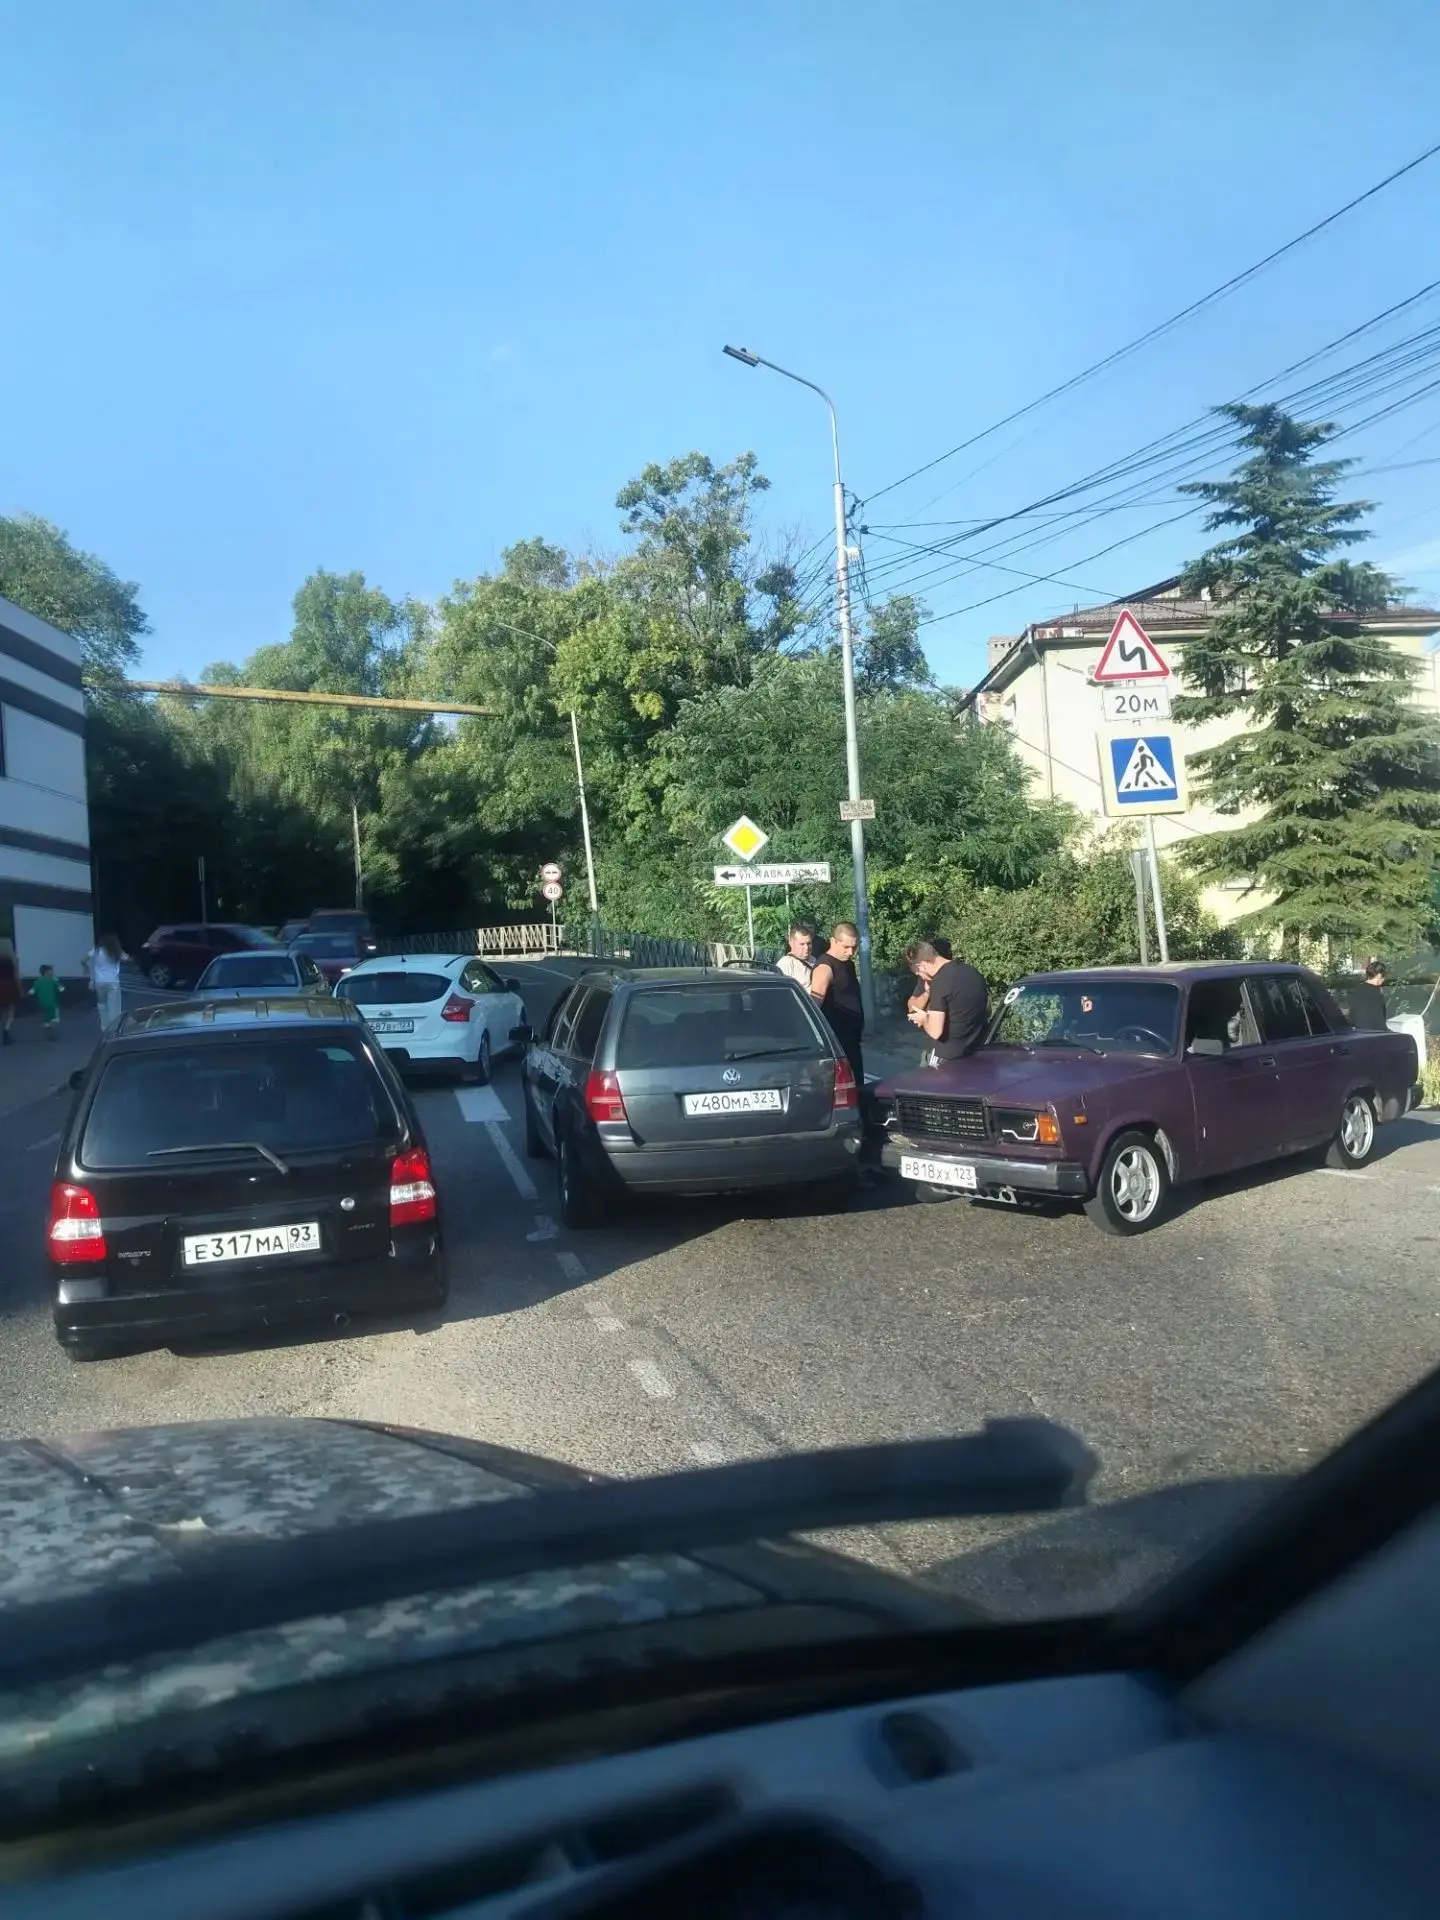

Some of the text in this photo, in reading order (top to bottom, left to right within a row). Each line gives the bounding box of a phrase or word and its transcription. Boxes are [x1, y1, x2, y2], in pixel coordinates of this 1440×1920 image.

[692, 1092, 775, 1111] У480МА 323
[905, 1162, 972, 1182] Р818ХХ 123
[195, 1226, 311, 1260] Е317МА 93
